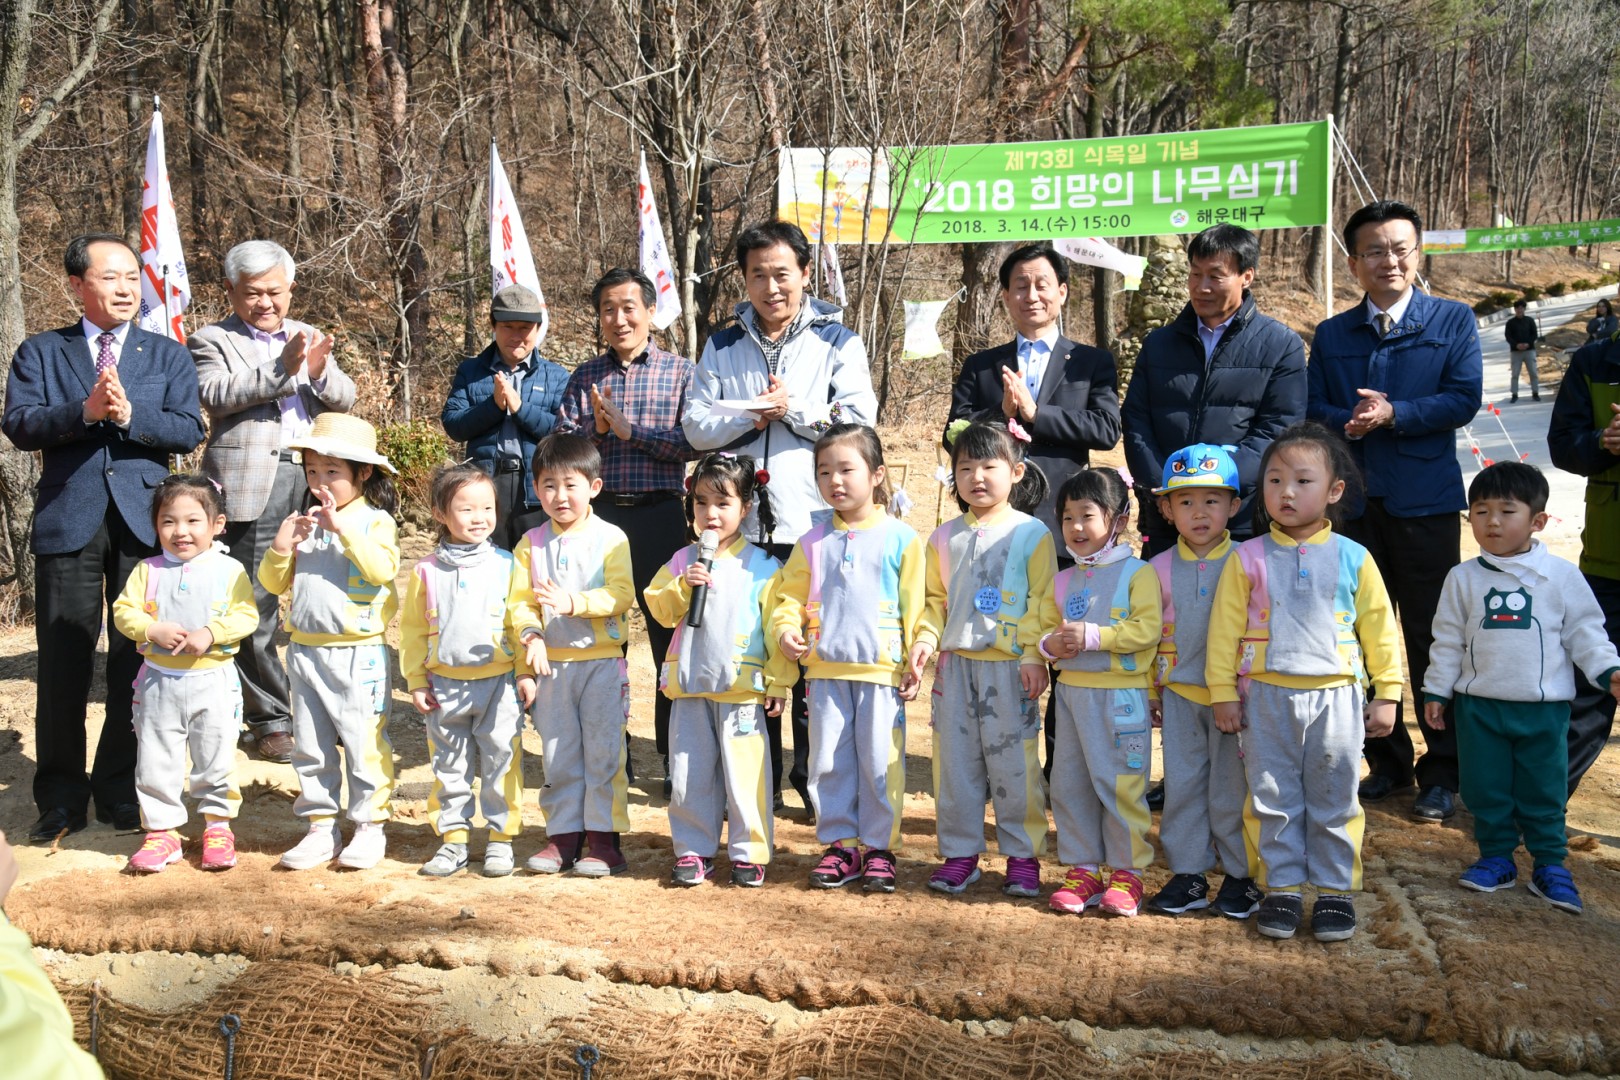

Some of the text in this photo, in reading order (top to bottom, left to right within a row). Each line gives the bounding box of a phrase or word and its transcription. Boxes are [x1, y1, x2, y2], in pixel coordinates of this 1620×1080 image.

[1004, 138, 1200, 171] 제73회 식목일 기념
[913, 159, 1298, 212] '2018 희망의 나무심기
[942, 220, 986, 233] 2018.
[998, 219, 1011, 232] 3.
[1082, 214, 1131, 230] 15:00
[1197, 205, 1266, 225] 해운대구
[1541, 229, 1580, 240] 푸르게
